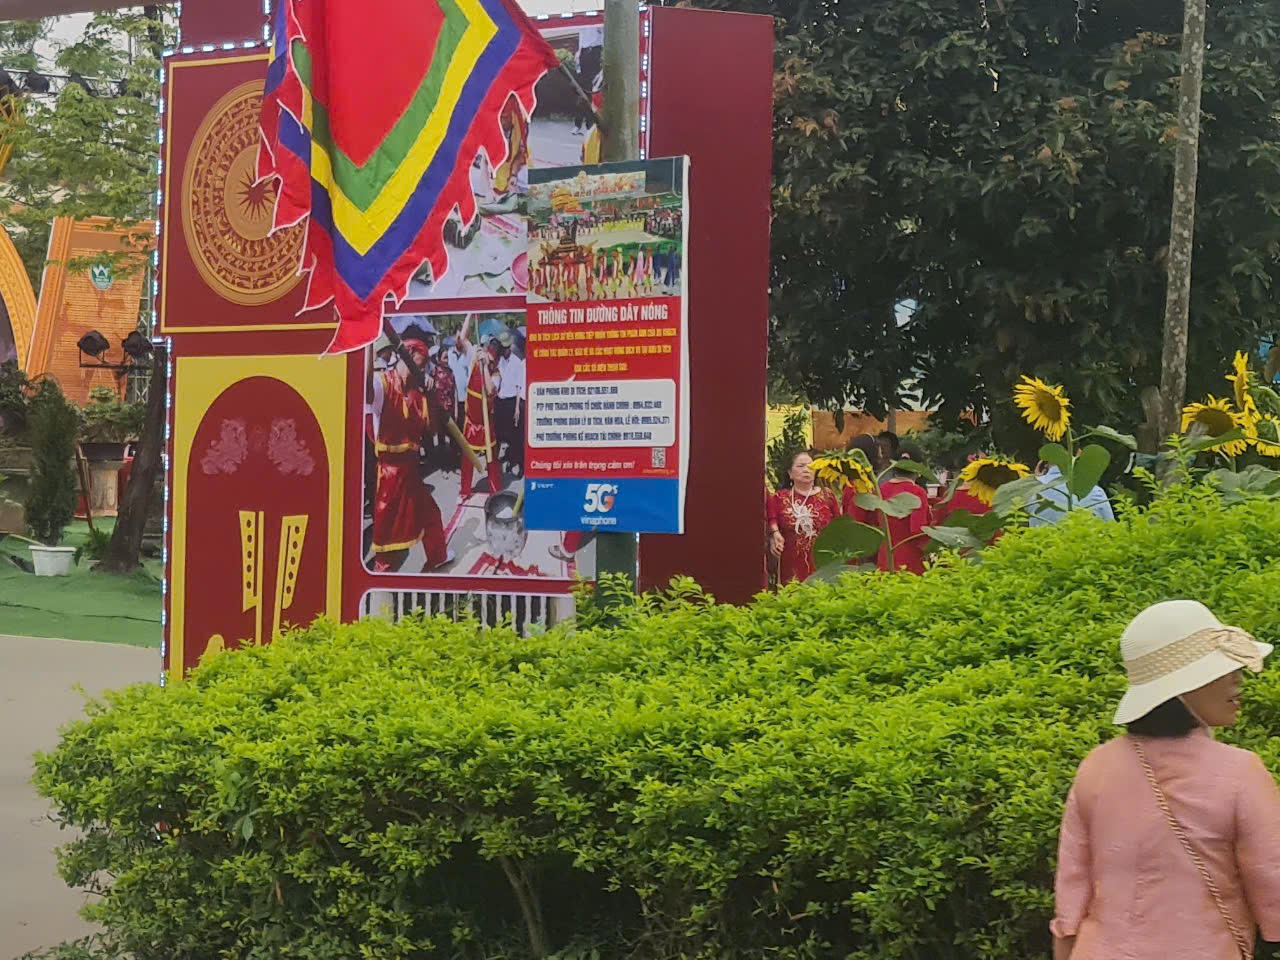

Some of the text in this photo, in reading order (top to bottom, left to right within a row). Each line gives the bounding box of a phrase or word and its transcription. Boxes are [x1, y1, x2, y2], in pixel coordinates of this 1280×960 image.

[537, 302, 668, 325] THÔNG TIN ĐƯỜNG DÂY NÓNG
